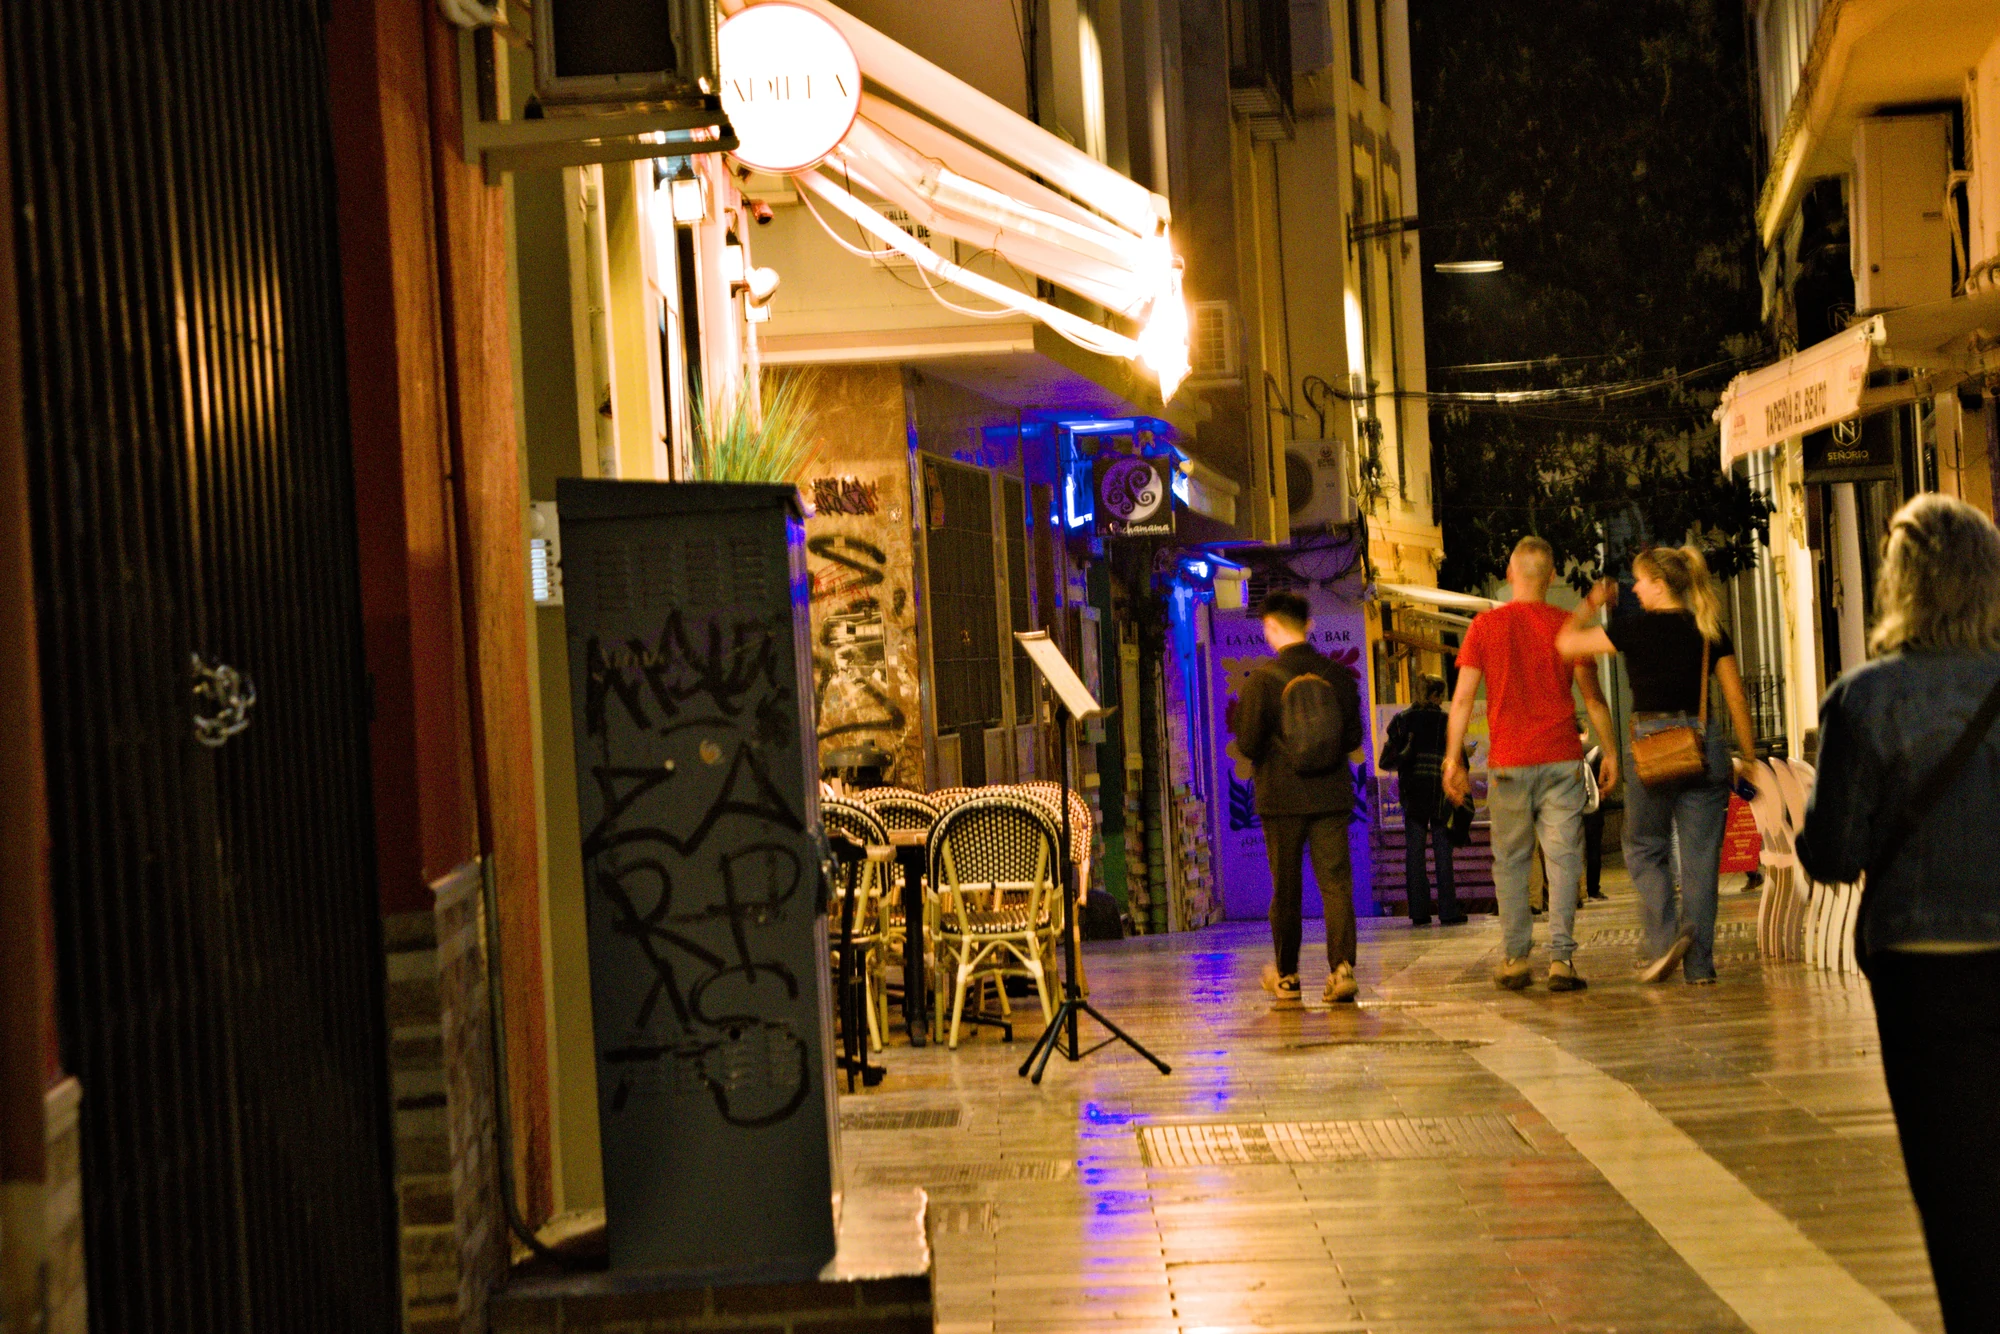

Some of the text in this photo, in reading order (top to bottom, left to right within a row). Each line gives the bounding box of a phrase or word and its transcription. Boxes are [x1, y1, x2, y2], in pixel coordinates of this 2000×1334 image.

[1794, 390, 1803, 424] EL
[1804, 380, 1827, 420] BEATO
[1226, 635, 1241, 646] LA
[1324, 630, 1350, 642] BAR
